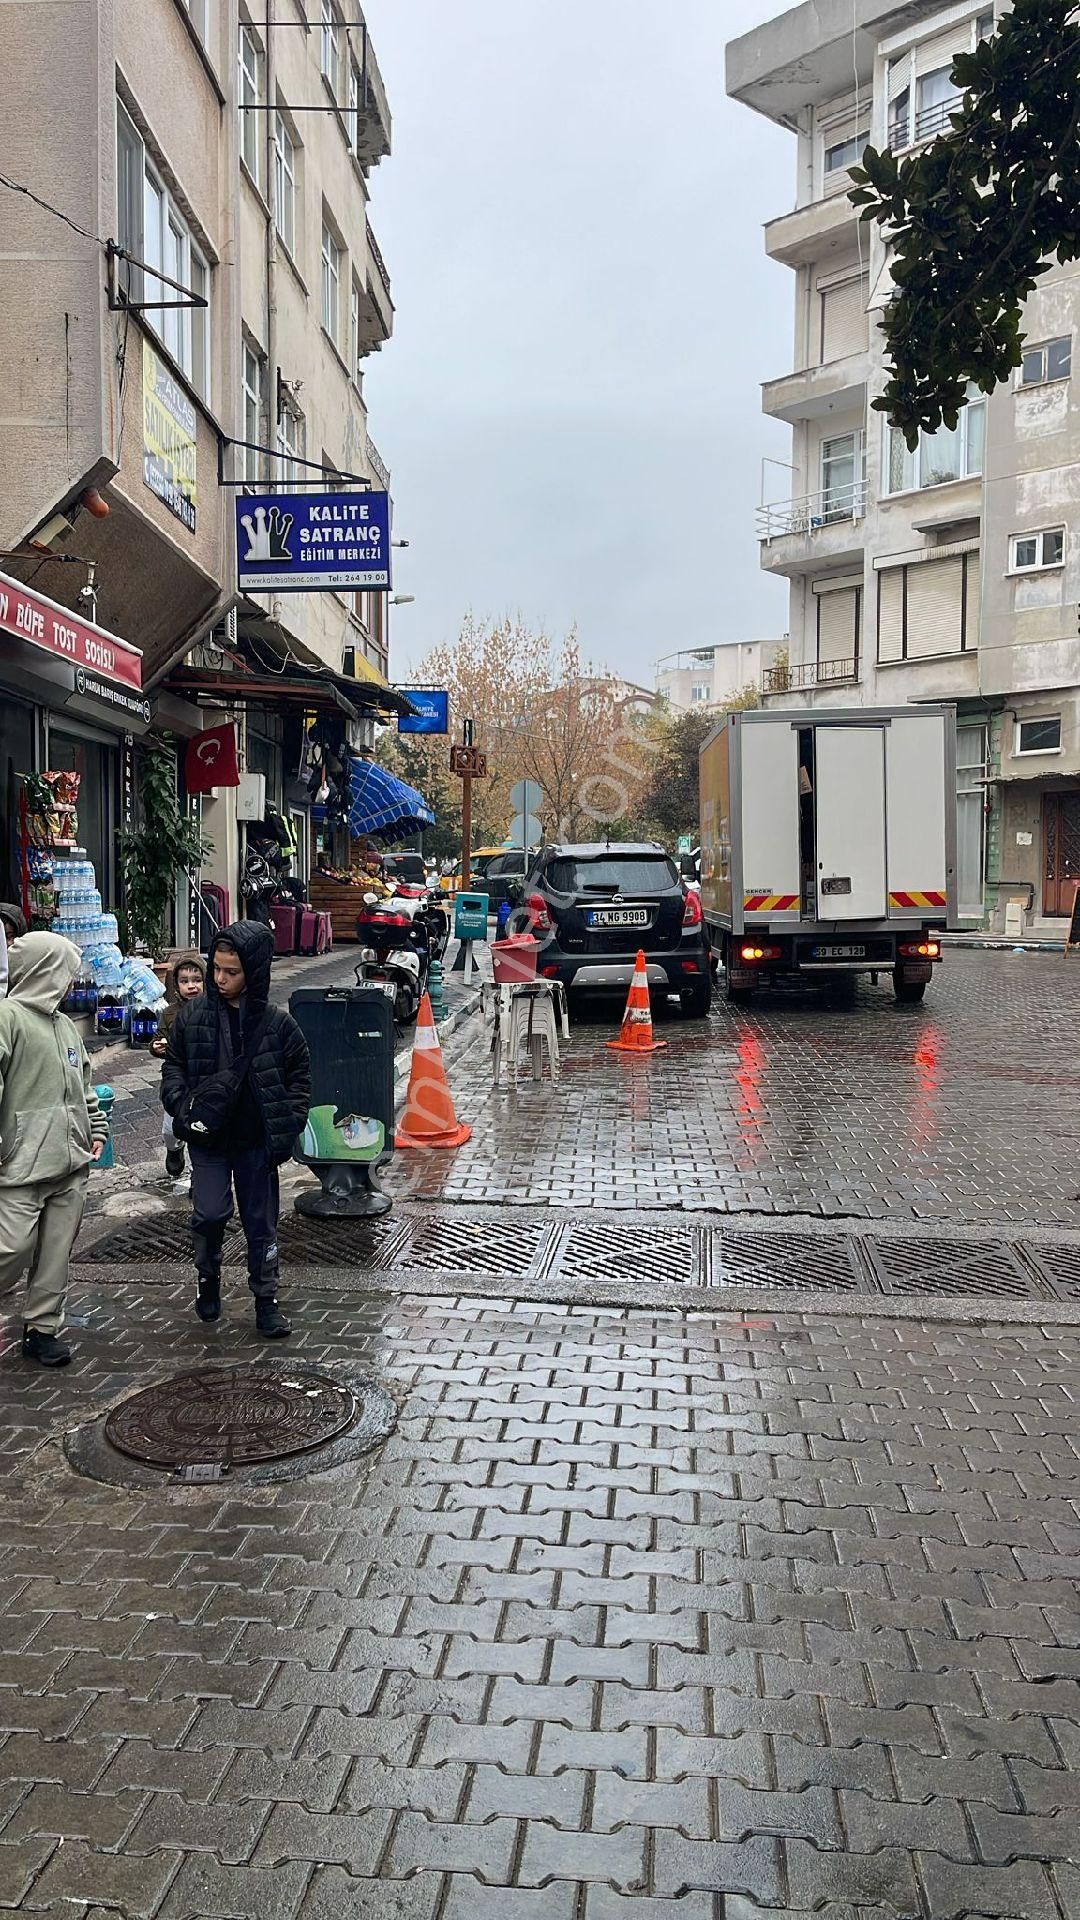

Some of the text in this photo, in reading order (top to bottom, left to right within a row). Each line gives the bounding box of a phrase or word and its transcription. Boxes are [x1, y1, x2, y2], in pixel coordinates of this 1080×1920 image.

[299, 526, 381, 545] SATRANÇ
[300, 547, 381, 562] EĞİTİM MERKEZİ
[328, 575, 342, 583] Tel:
[345, 574, 360, 582] 264
[363, 574, 372, 582] 19
[375, 573, 385, 581] 00
[16, 602, 45, 638] BÜFE
[52, 622, 77, 653] TOST
[593, 911, 646, 922] 34 NG 9908
[831, 947, 843, 955] EC
[849, 946, 864, 955] 129
